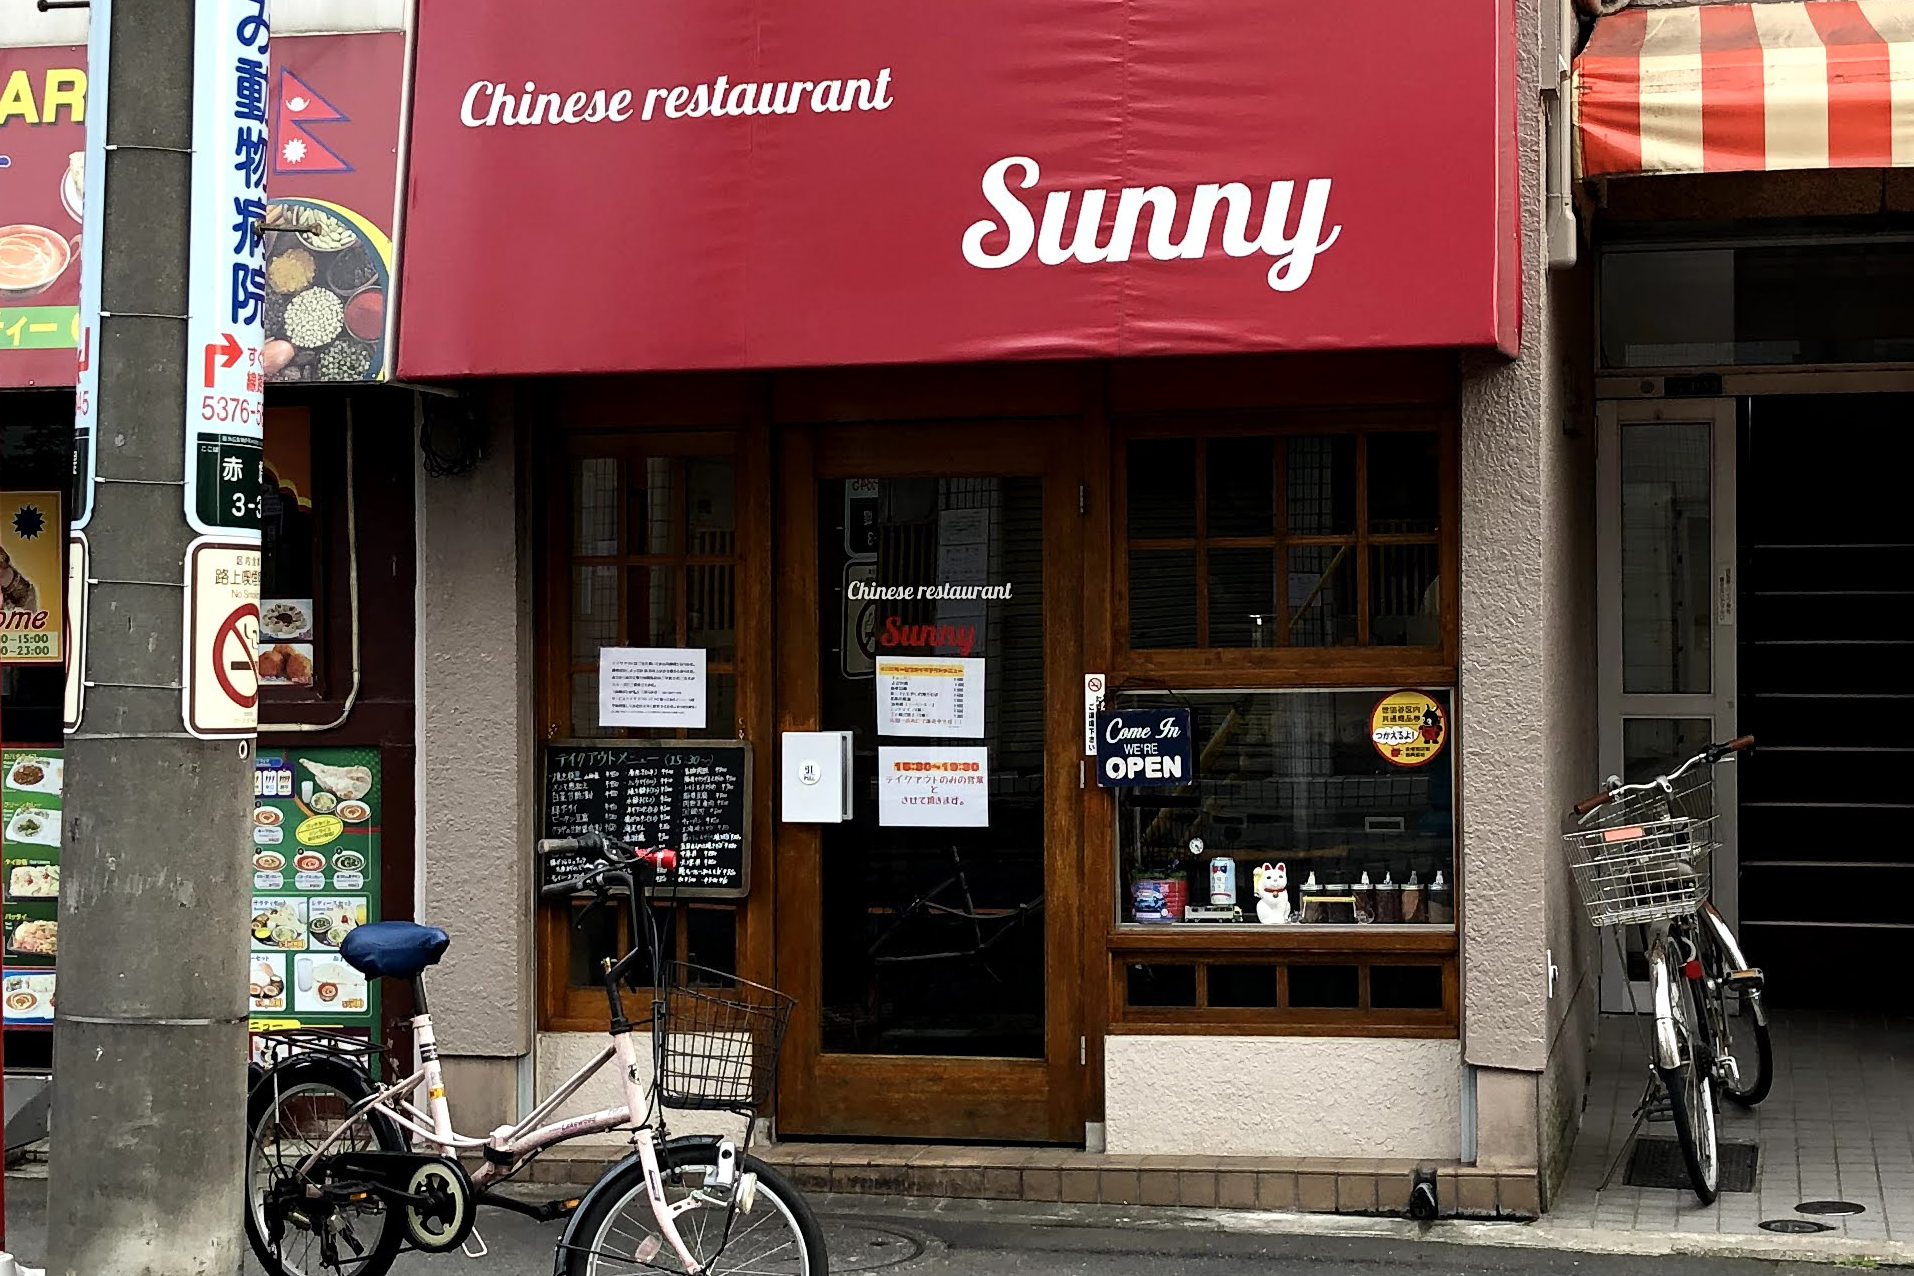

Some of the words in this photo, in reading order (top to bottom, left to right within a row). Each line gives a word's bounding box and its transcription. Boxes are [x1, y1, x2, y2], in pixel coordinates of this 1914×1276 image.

[460, 80, 633, 127] Chinese
[641, 67, 894, 121] restaurant
[961, 156, 1342, 292] Sunny
[847, 581, 914, 600] Chinese
[917, 582, 1012, 600] restaurant
[880, 614, 977, 656] Sunny
[1105, 717, 1152, 744] Come
[1155, 717, 1182, 739] In
[555, 751, 660, 768] テイクアウトメニュー
[1123, 743, 1159, 755] WE'RE
[1105, 755, 1182, 779] OPEN
